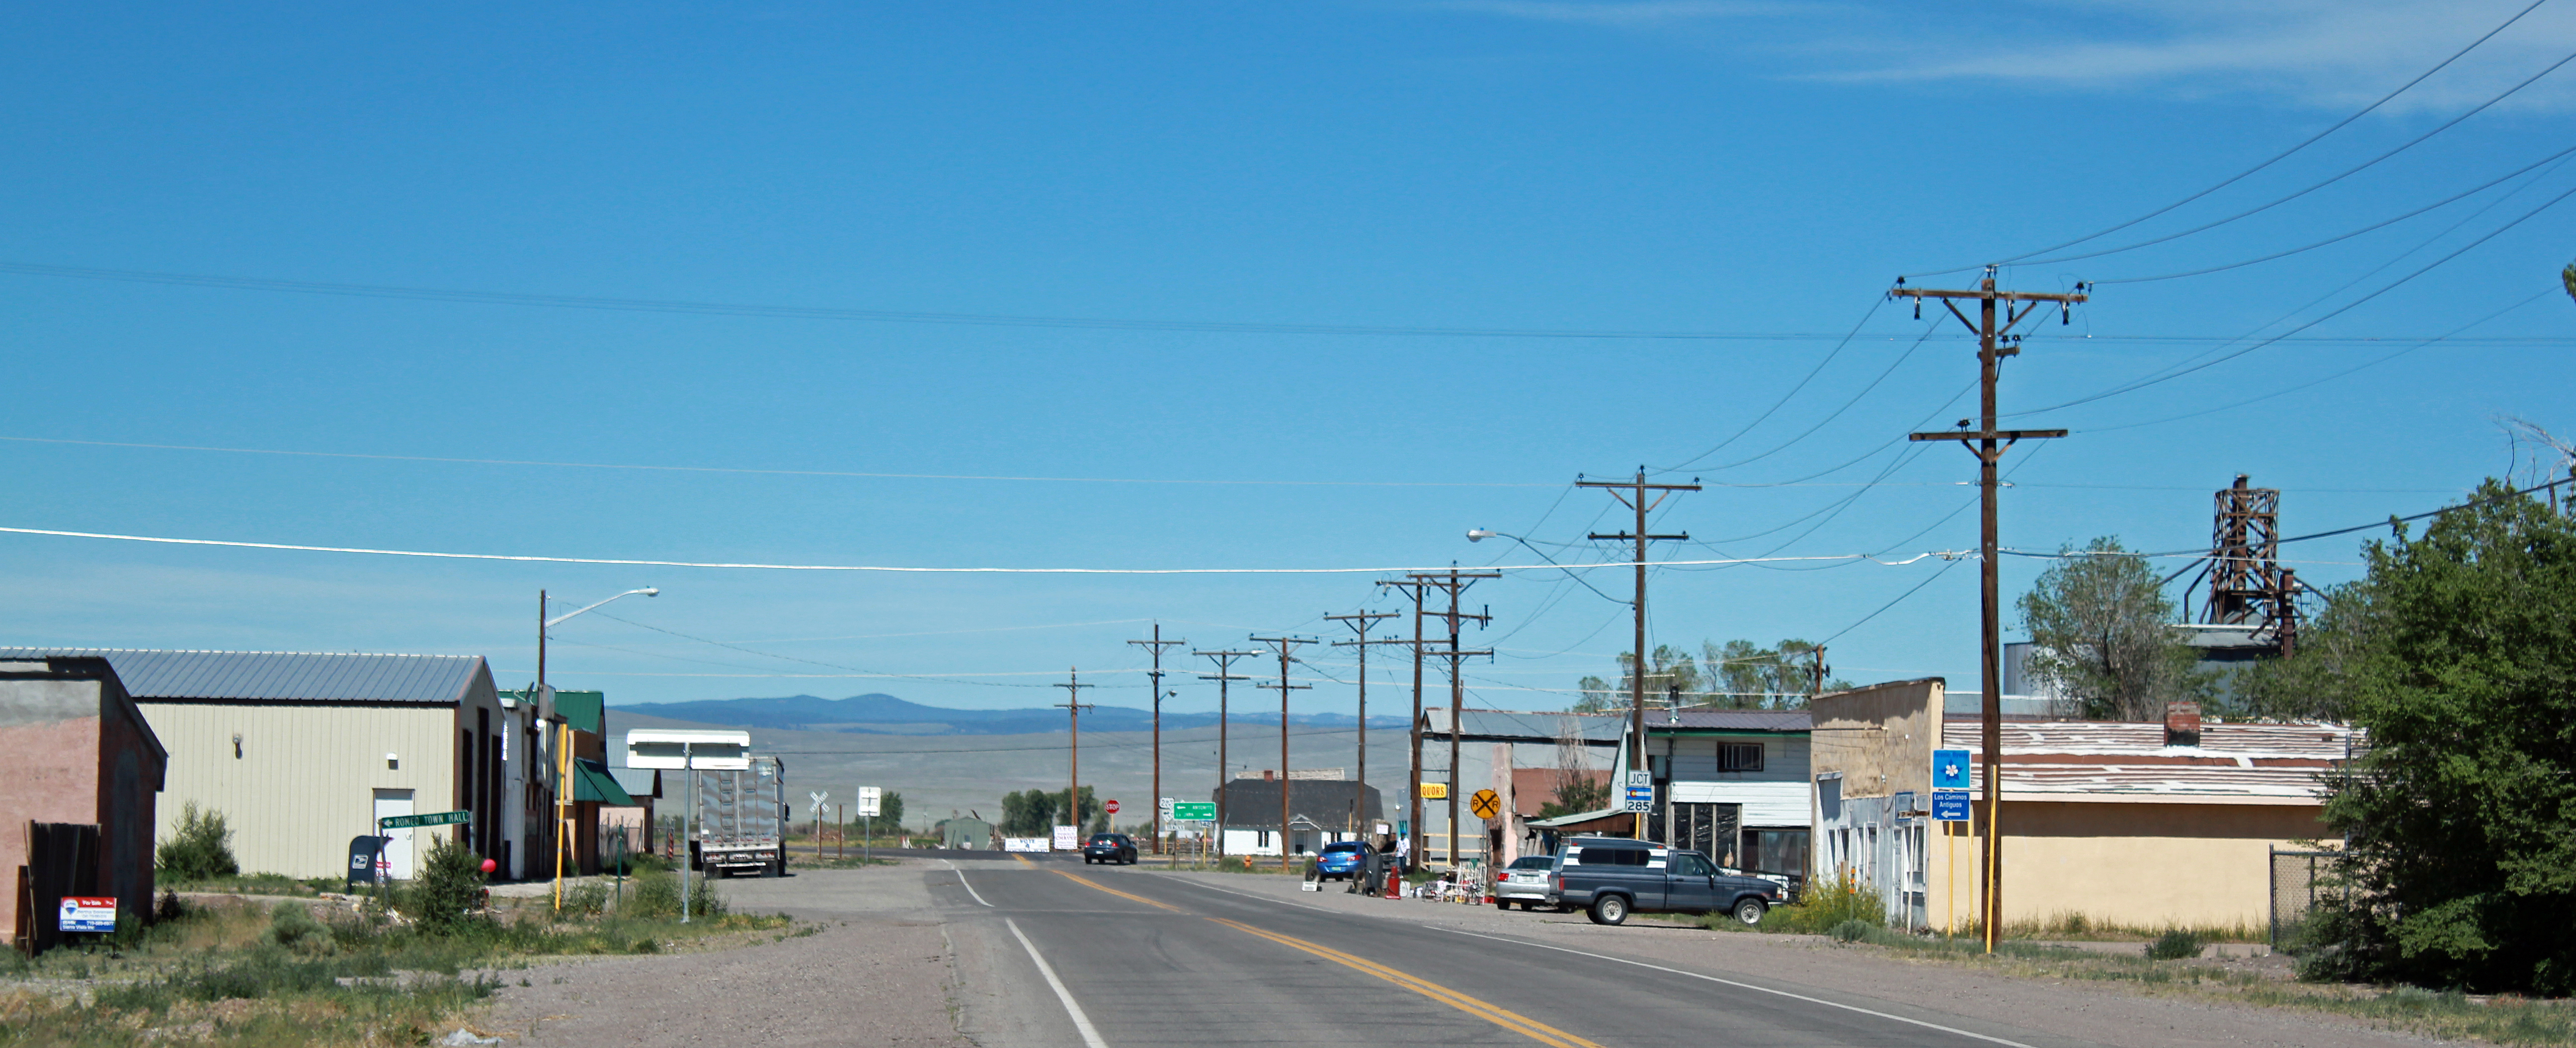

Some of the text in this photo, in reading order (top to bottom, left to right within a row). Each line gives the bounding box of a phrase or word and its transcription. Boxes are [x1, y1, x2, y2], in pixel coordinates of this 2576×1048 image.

[1631, 774, 1649, 784] JCT
[1422, 787, 1445, 796] QUORS
[1627, 801, 1649, 811] 285
[395, 813, 467, 827] ROMEO TOWN HALL
